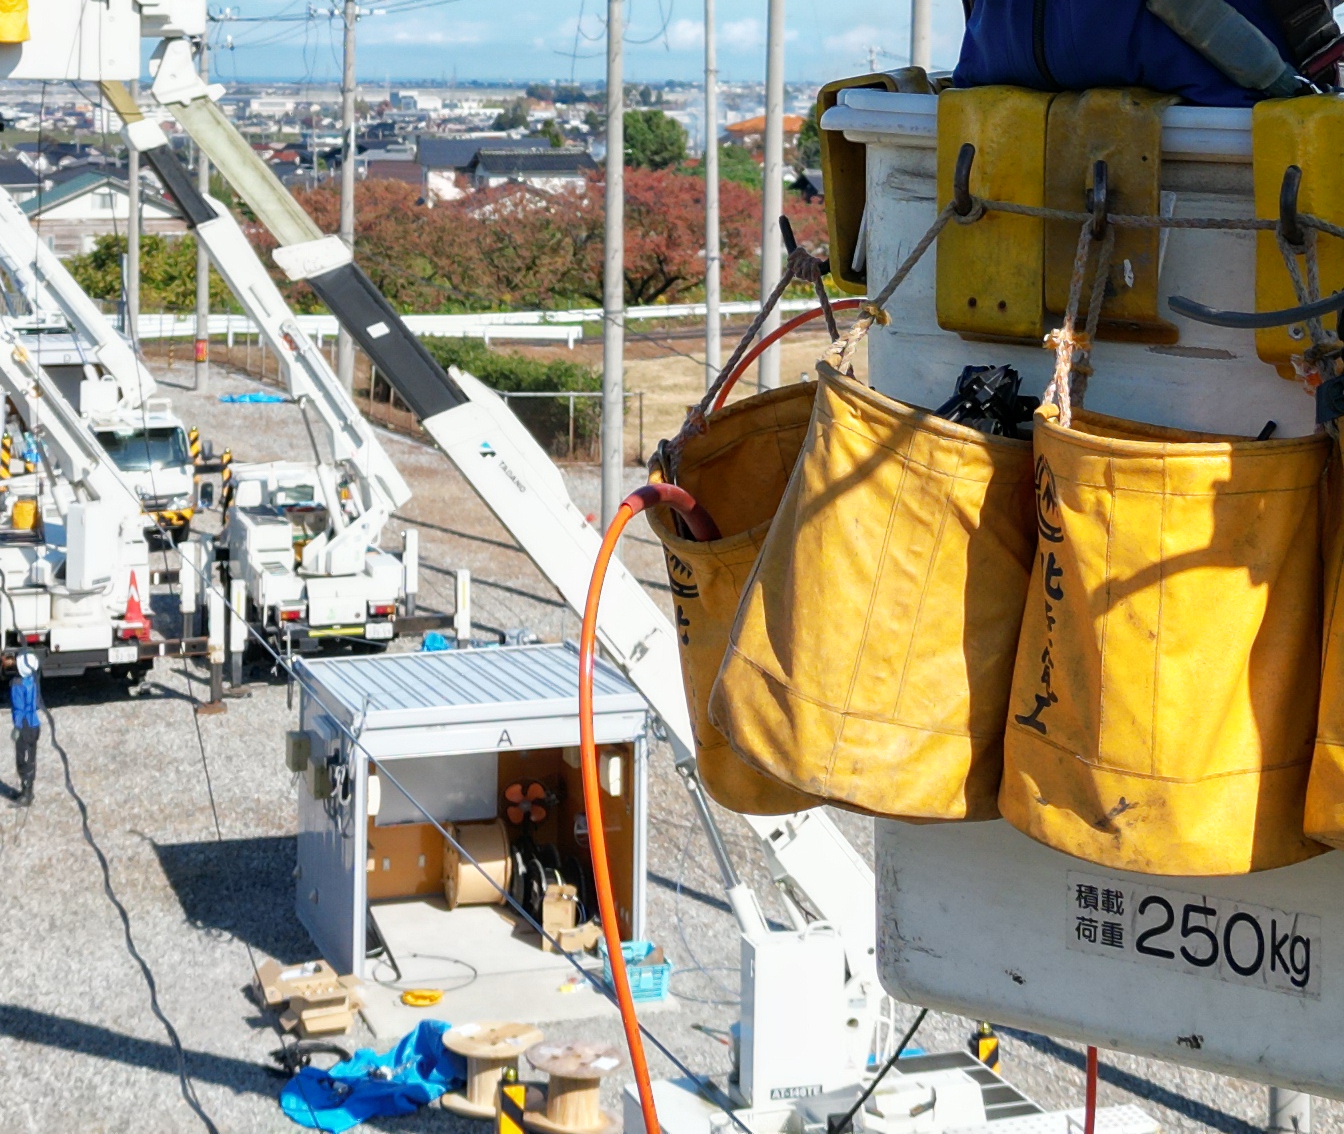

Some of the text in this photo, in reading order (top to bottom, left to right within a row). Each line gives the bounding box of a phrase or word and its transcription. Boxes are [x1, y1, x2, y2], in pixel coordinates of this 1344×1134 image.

[497, 729, 513, 747] A
[1076, 883, 1124, 916] 積載
[1076, 915, 1124, 949] 荷重
[1136, 895, 1310, 987] 250kg
